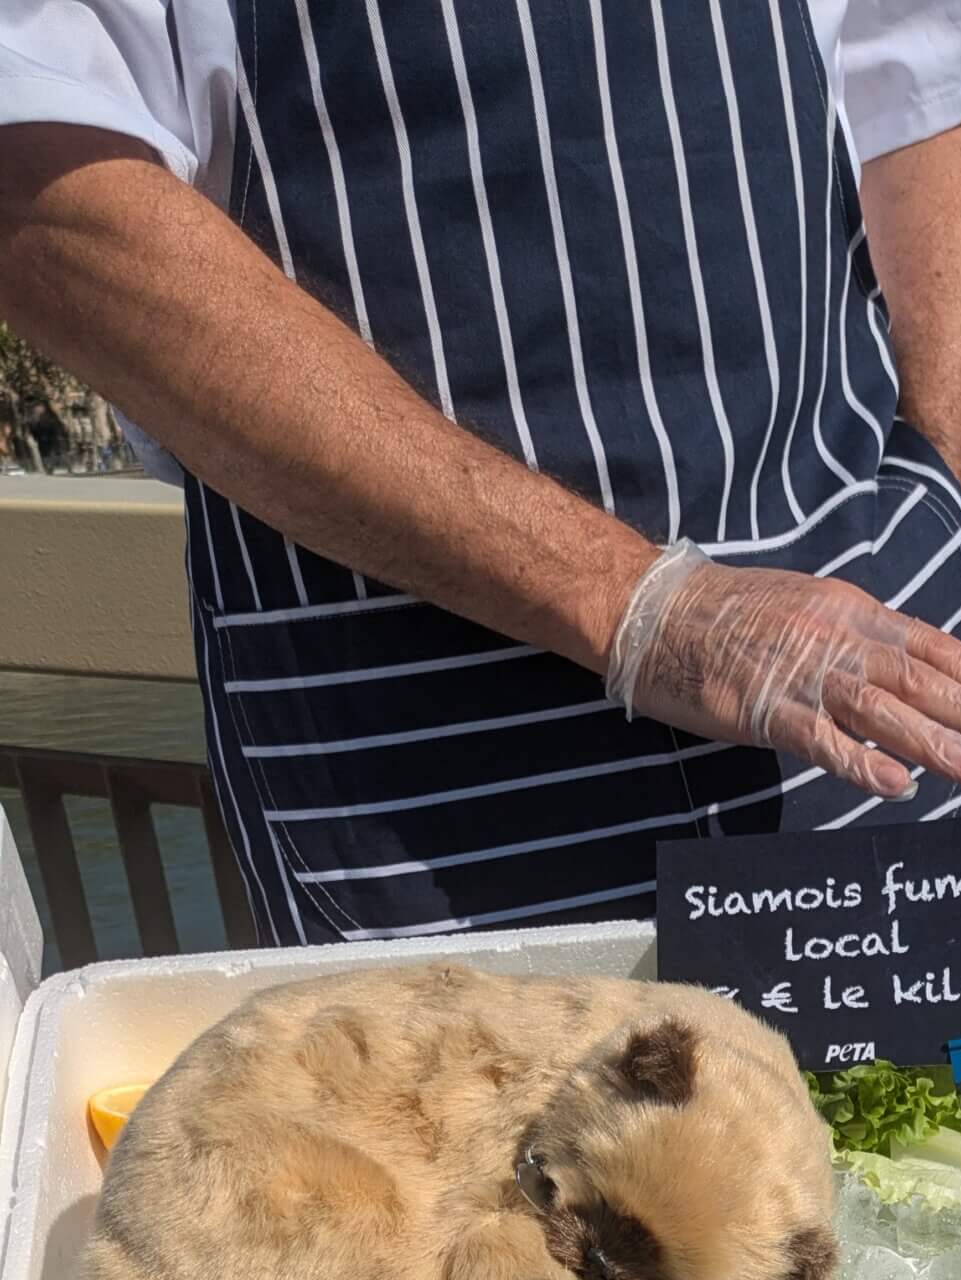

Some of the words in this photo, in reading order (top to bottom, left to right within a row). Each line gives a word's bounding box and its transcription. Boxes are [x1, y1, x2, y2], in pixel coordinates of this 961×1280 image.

[684, 877, 862, 920] Siamois
[784, 919, 910, 962] local
[823, 975, 869, 1010] le
